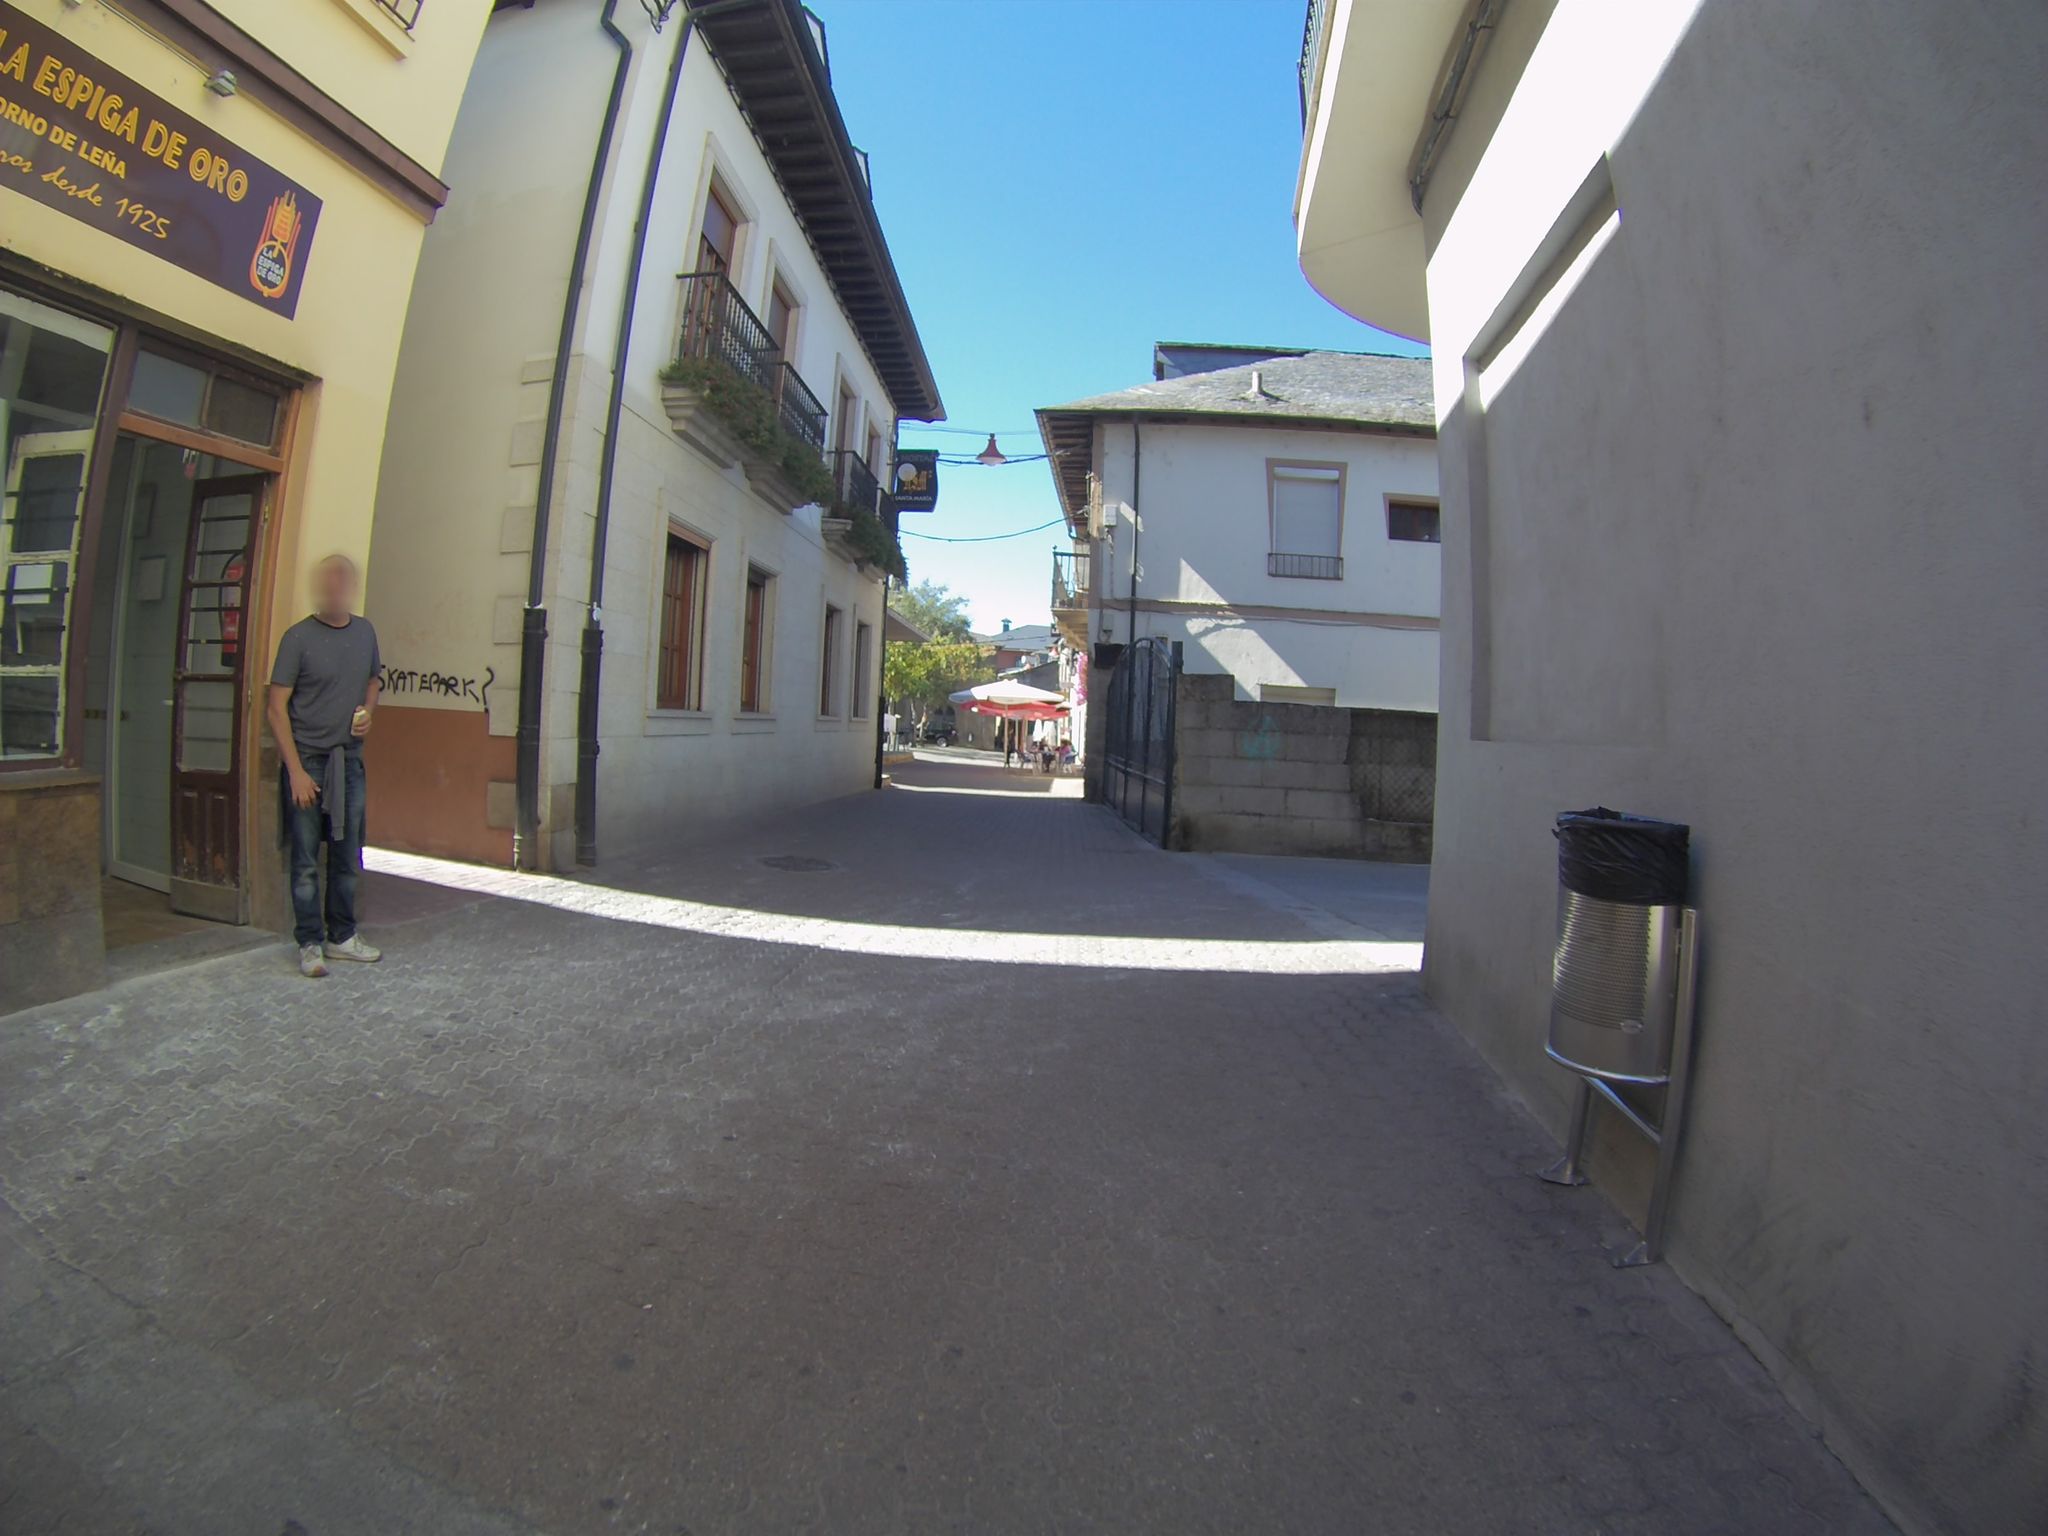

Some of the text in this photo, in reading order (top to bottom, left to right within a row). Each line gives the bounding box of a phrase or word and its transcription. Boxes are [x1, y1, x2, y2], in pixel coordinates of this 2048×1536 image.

[33, 55, 139, 144] ESPIGA
[141, 119, 188, 170] DE
[189, 148, 249, 203] ORO
[48, 125, 78, 152] DE
[77, 141, 127, 179] LEÑA
[41, 166, 103, 207] desde
[115, 198, 171, 240] 1925
[257, 256, 285, 276] ESPIGA
[262, 247, 274, 259] LA
[256, 266, 282, 285] DE ORO
